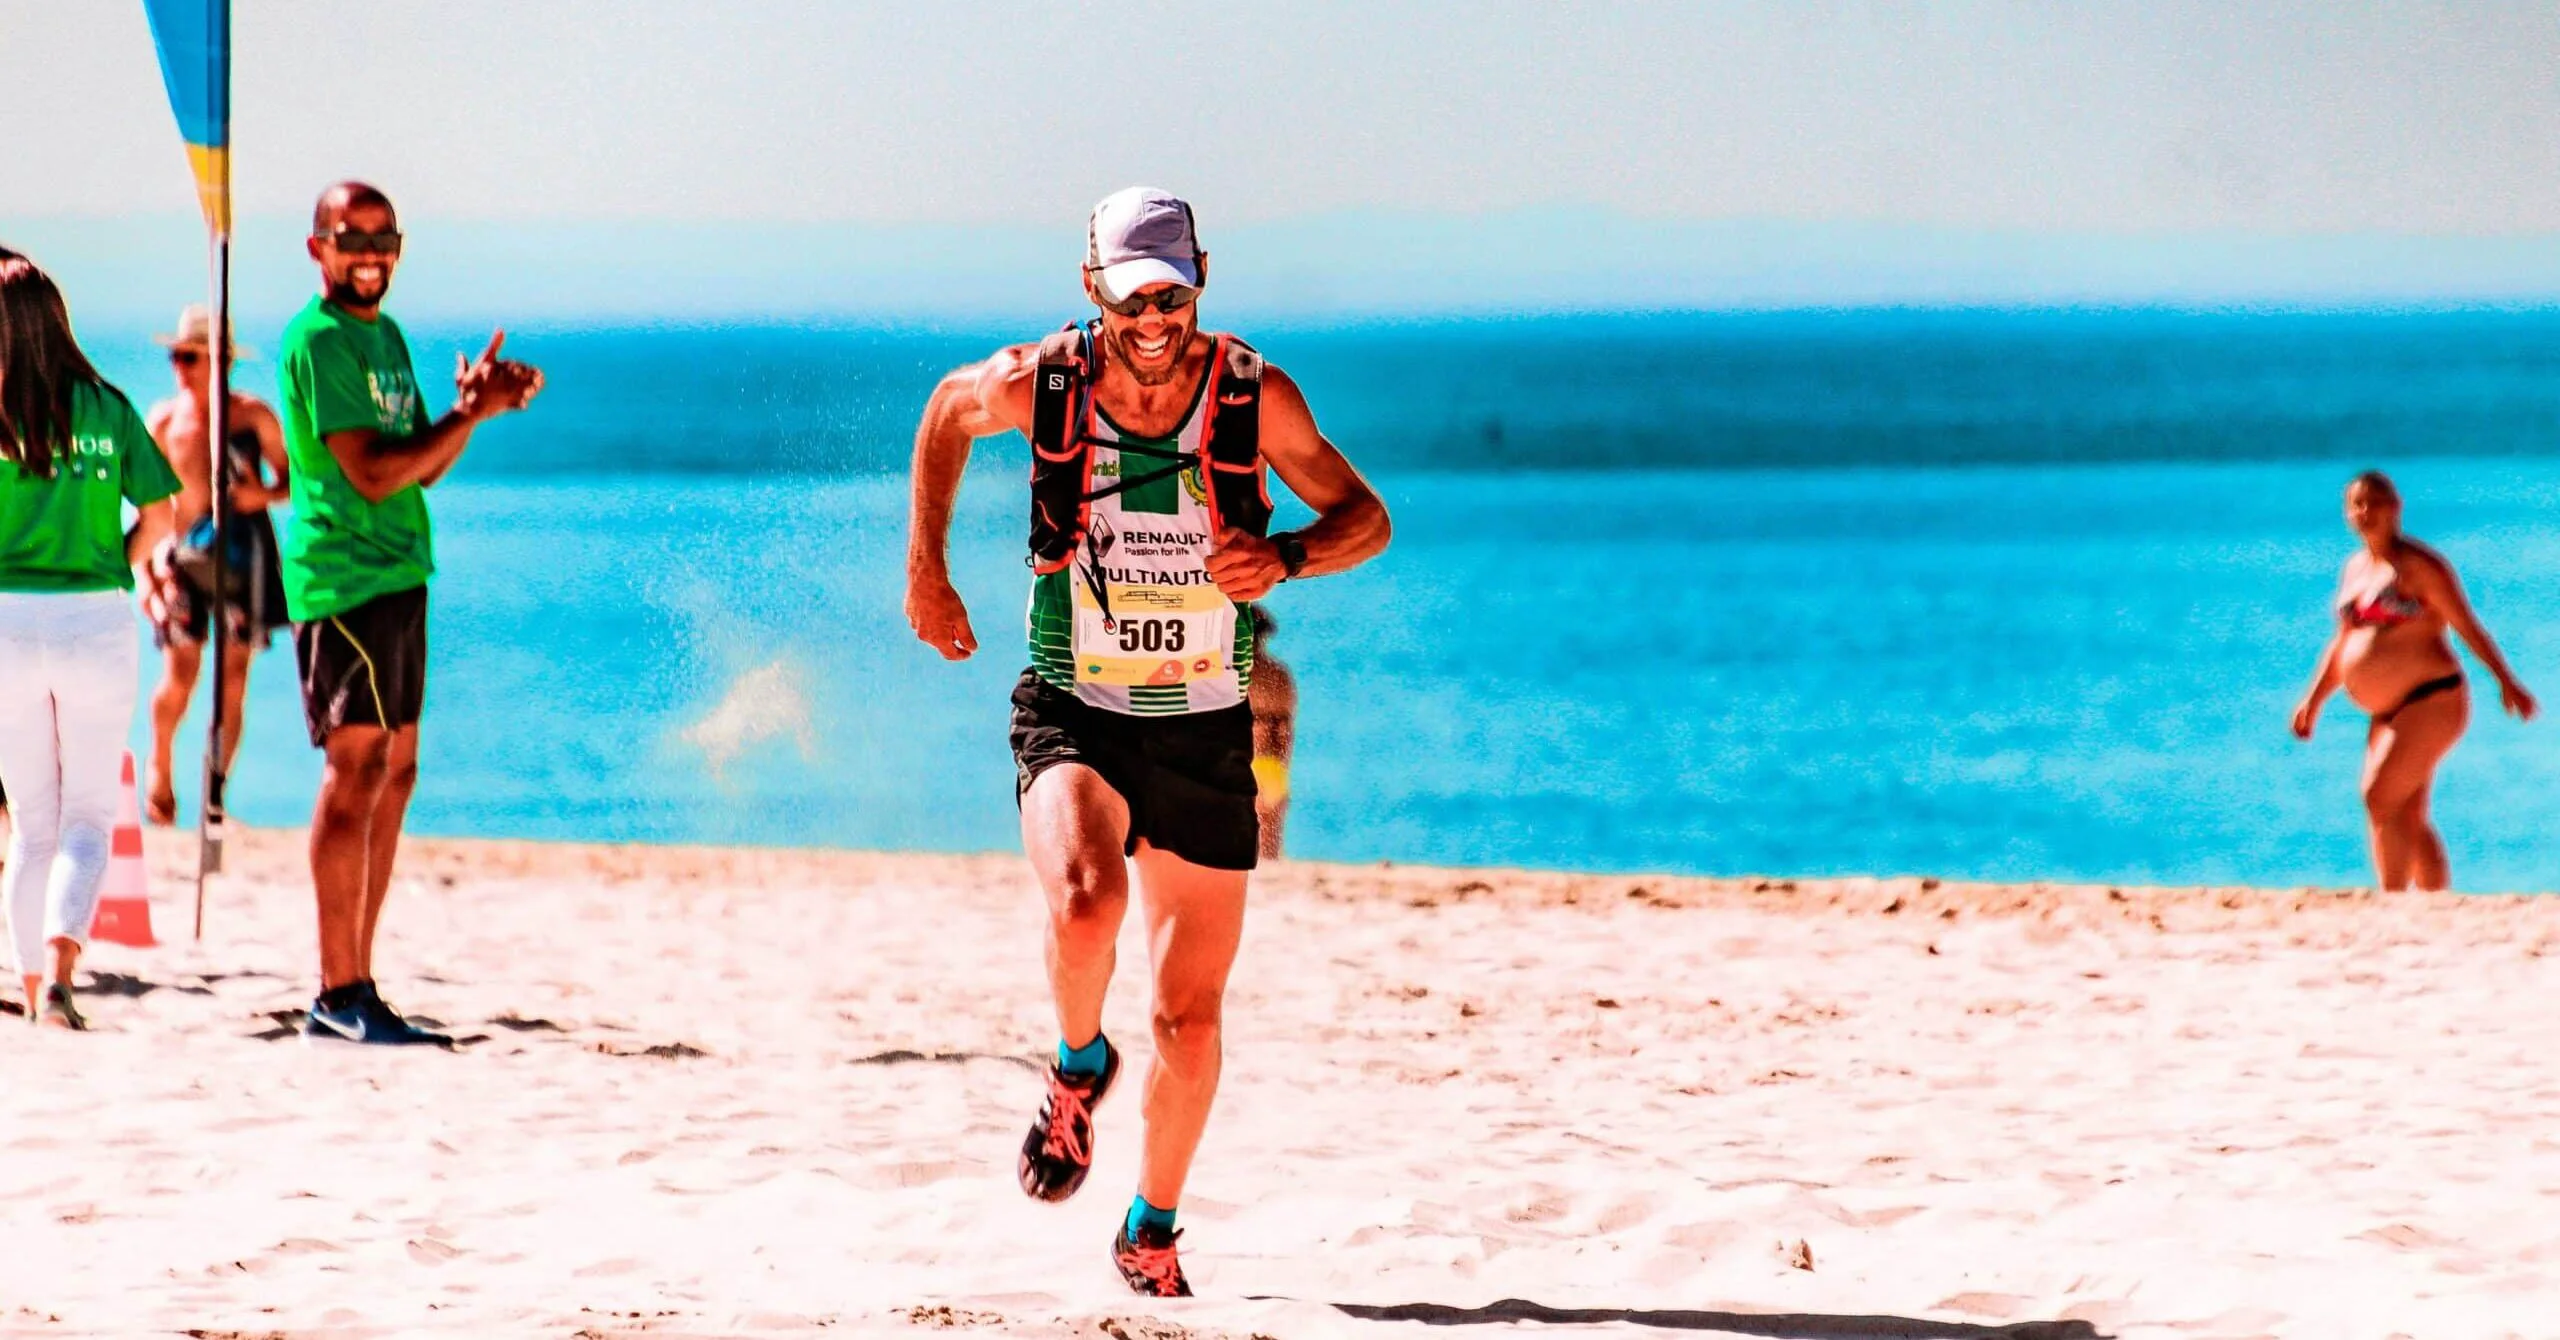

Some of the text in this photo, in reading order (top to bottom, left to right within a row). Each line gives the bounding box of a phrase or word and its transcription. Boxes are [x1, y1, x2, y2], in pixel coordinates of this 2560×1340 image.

[1123, 531, 1207, 545] RENAULT
[1125, 547, 1190, 556] Passion for life
[1119, 619, 1185, 652] 503
